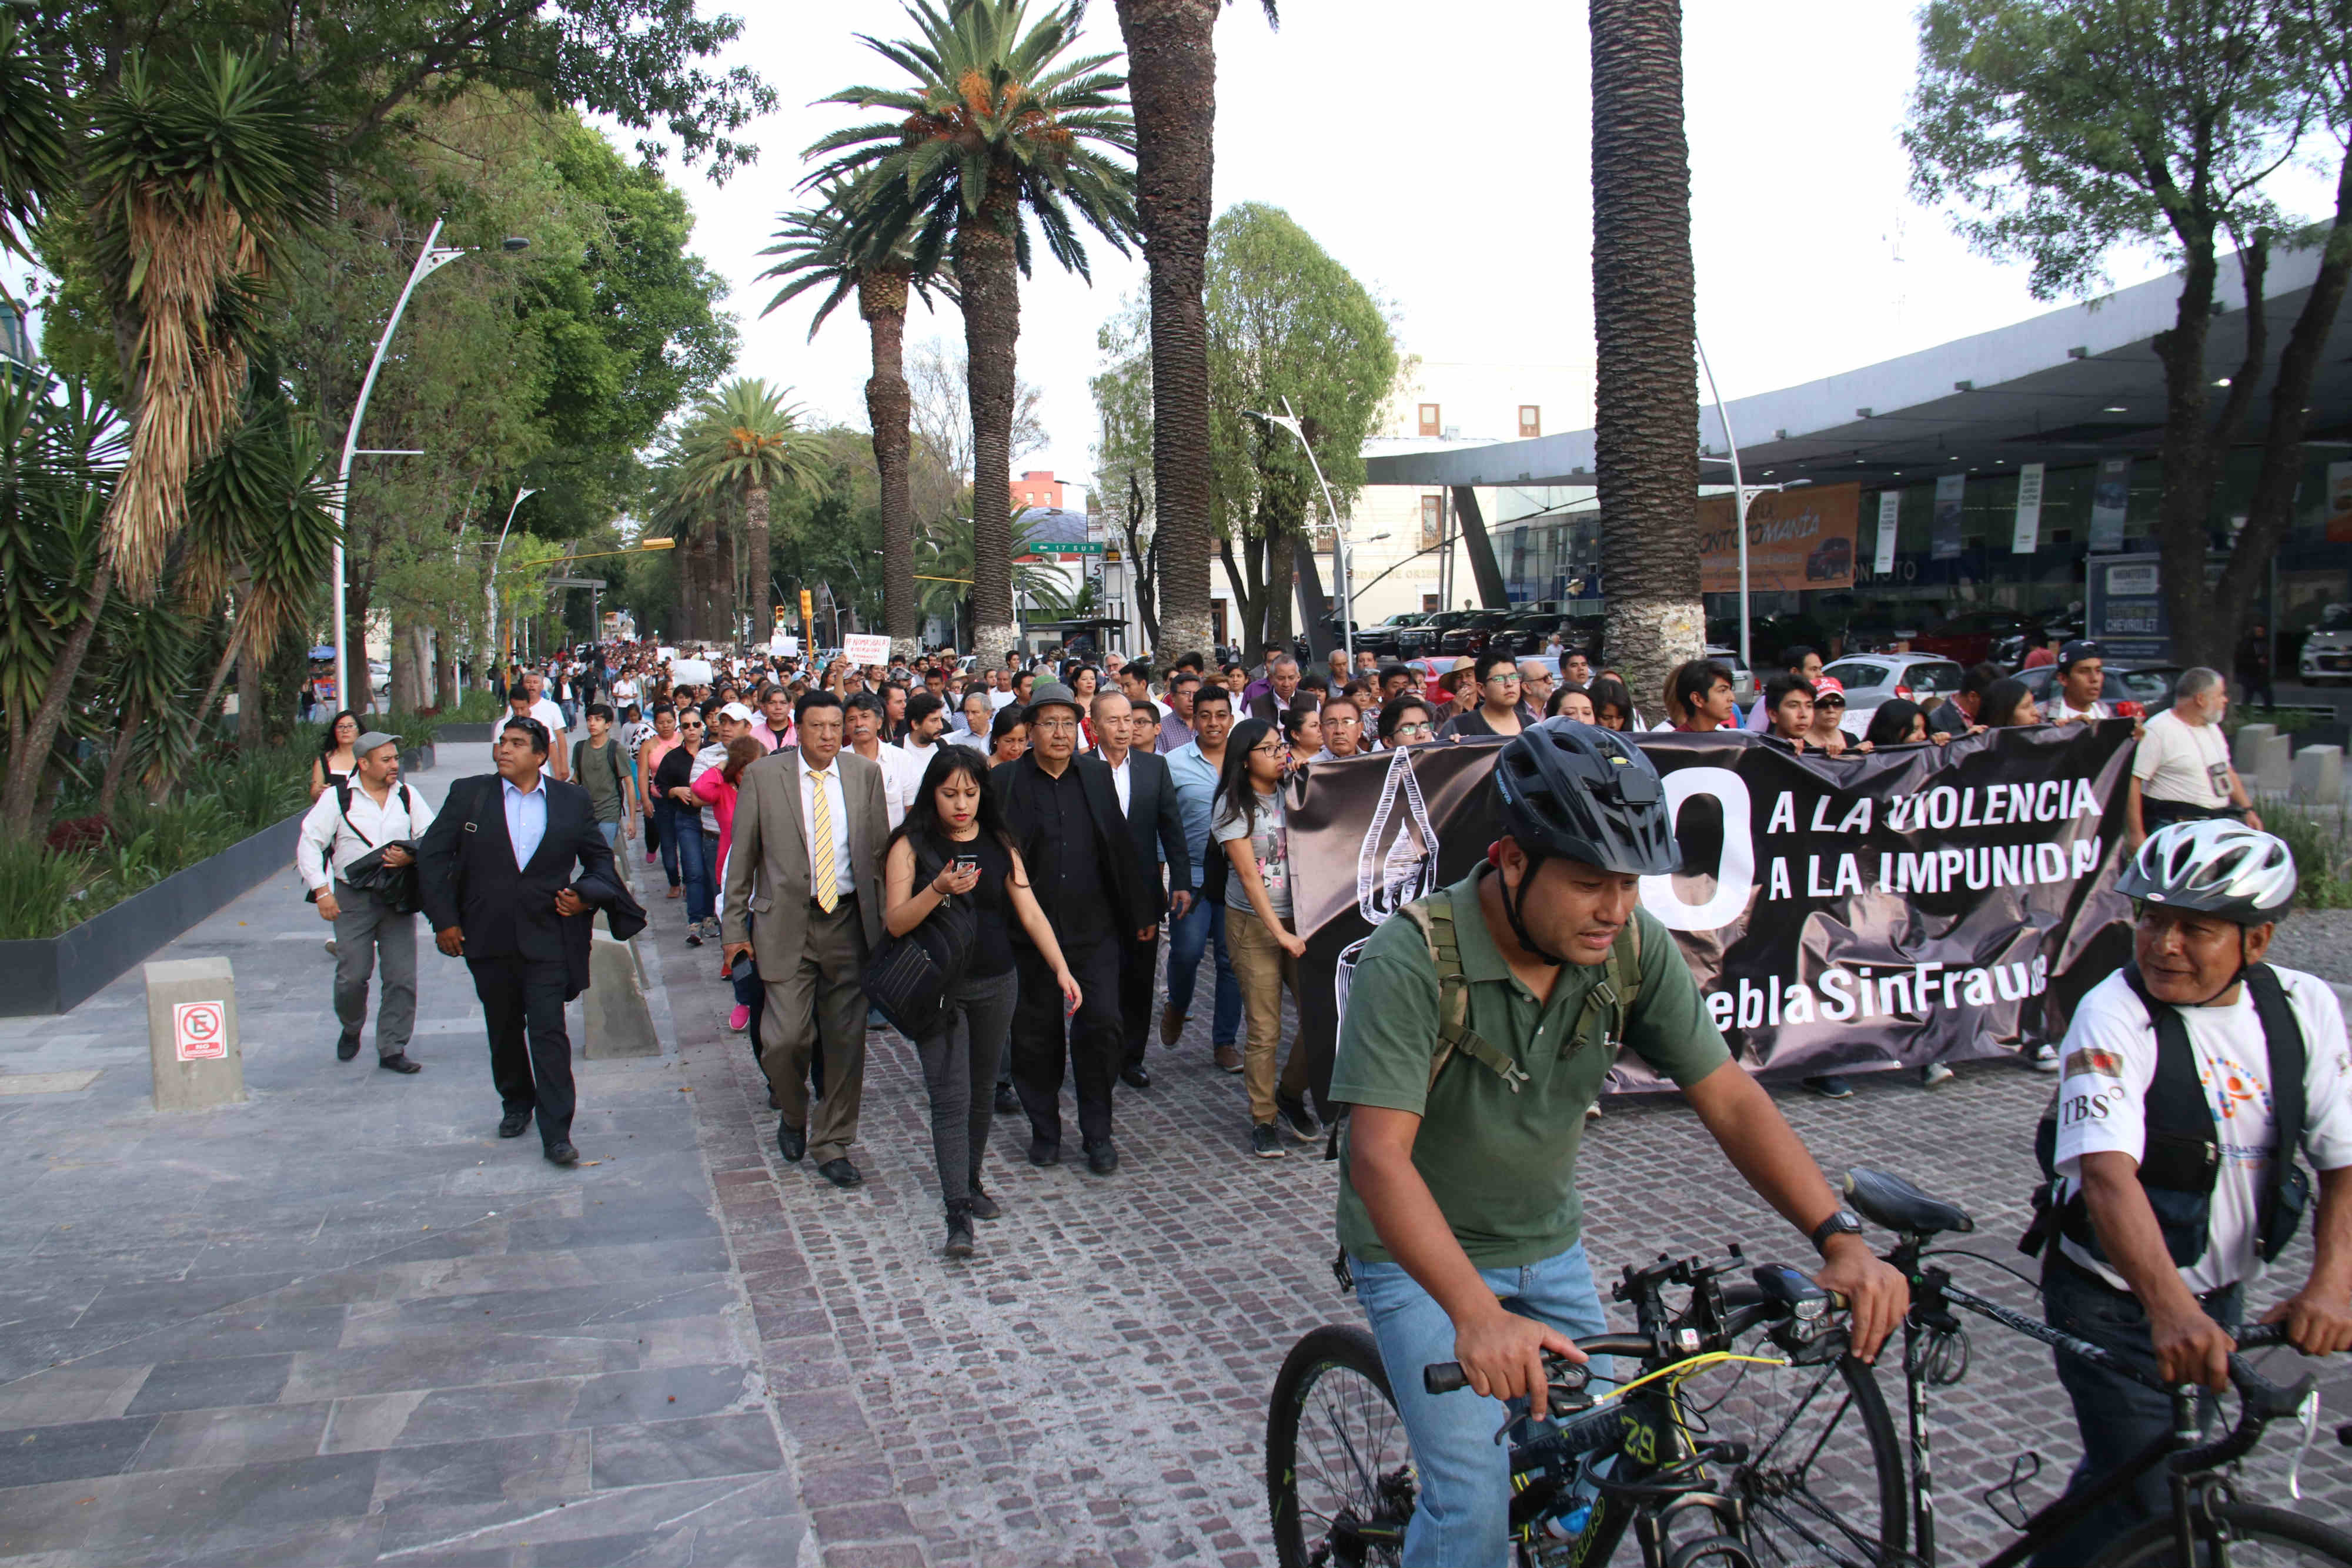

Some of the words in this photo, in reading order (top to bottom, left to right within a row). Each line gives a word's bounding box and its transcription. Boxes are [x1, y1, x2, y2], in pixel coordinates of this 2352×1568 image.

[1767, 791, 1796, 834] A
[1810, 795, 1873, 834] LA
[1887, 777, 2103, 830] VIOLENCIA
[1769, 857, 1793, 901] A
[1807, 853, 1863, 897] LA
[1621, 1415, 1656, 1464] 29
